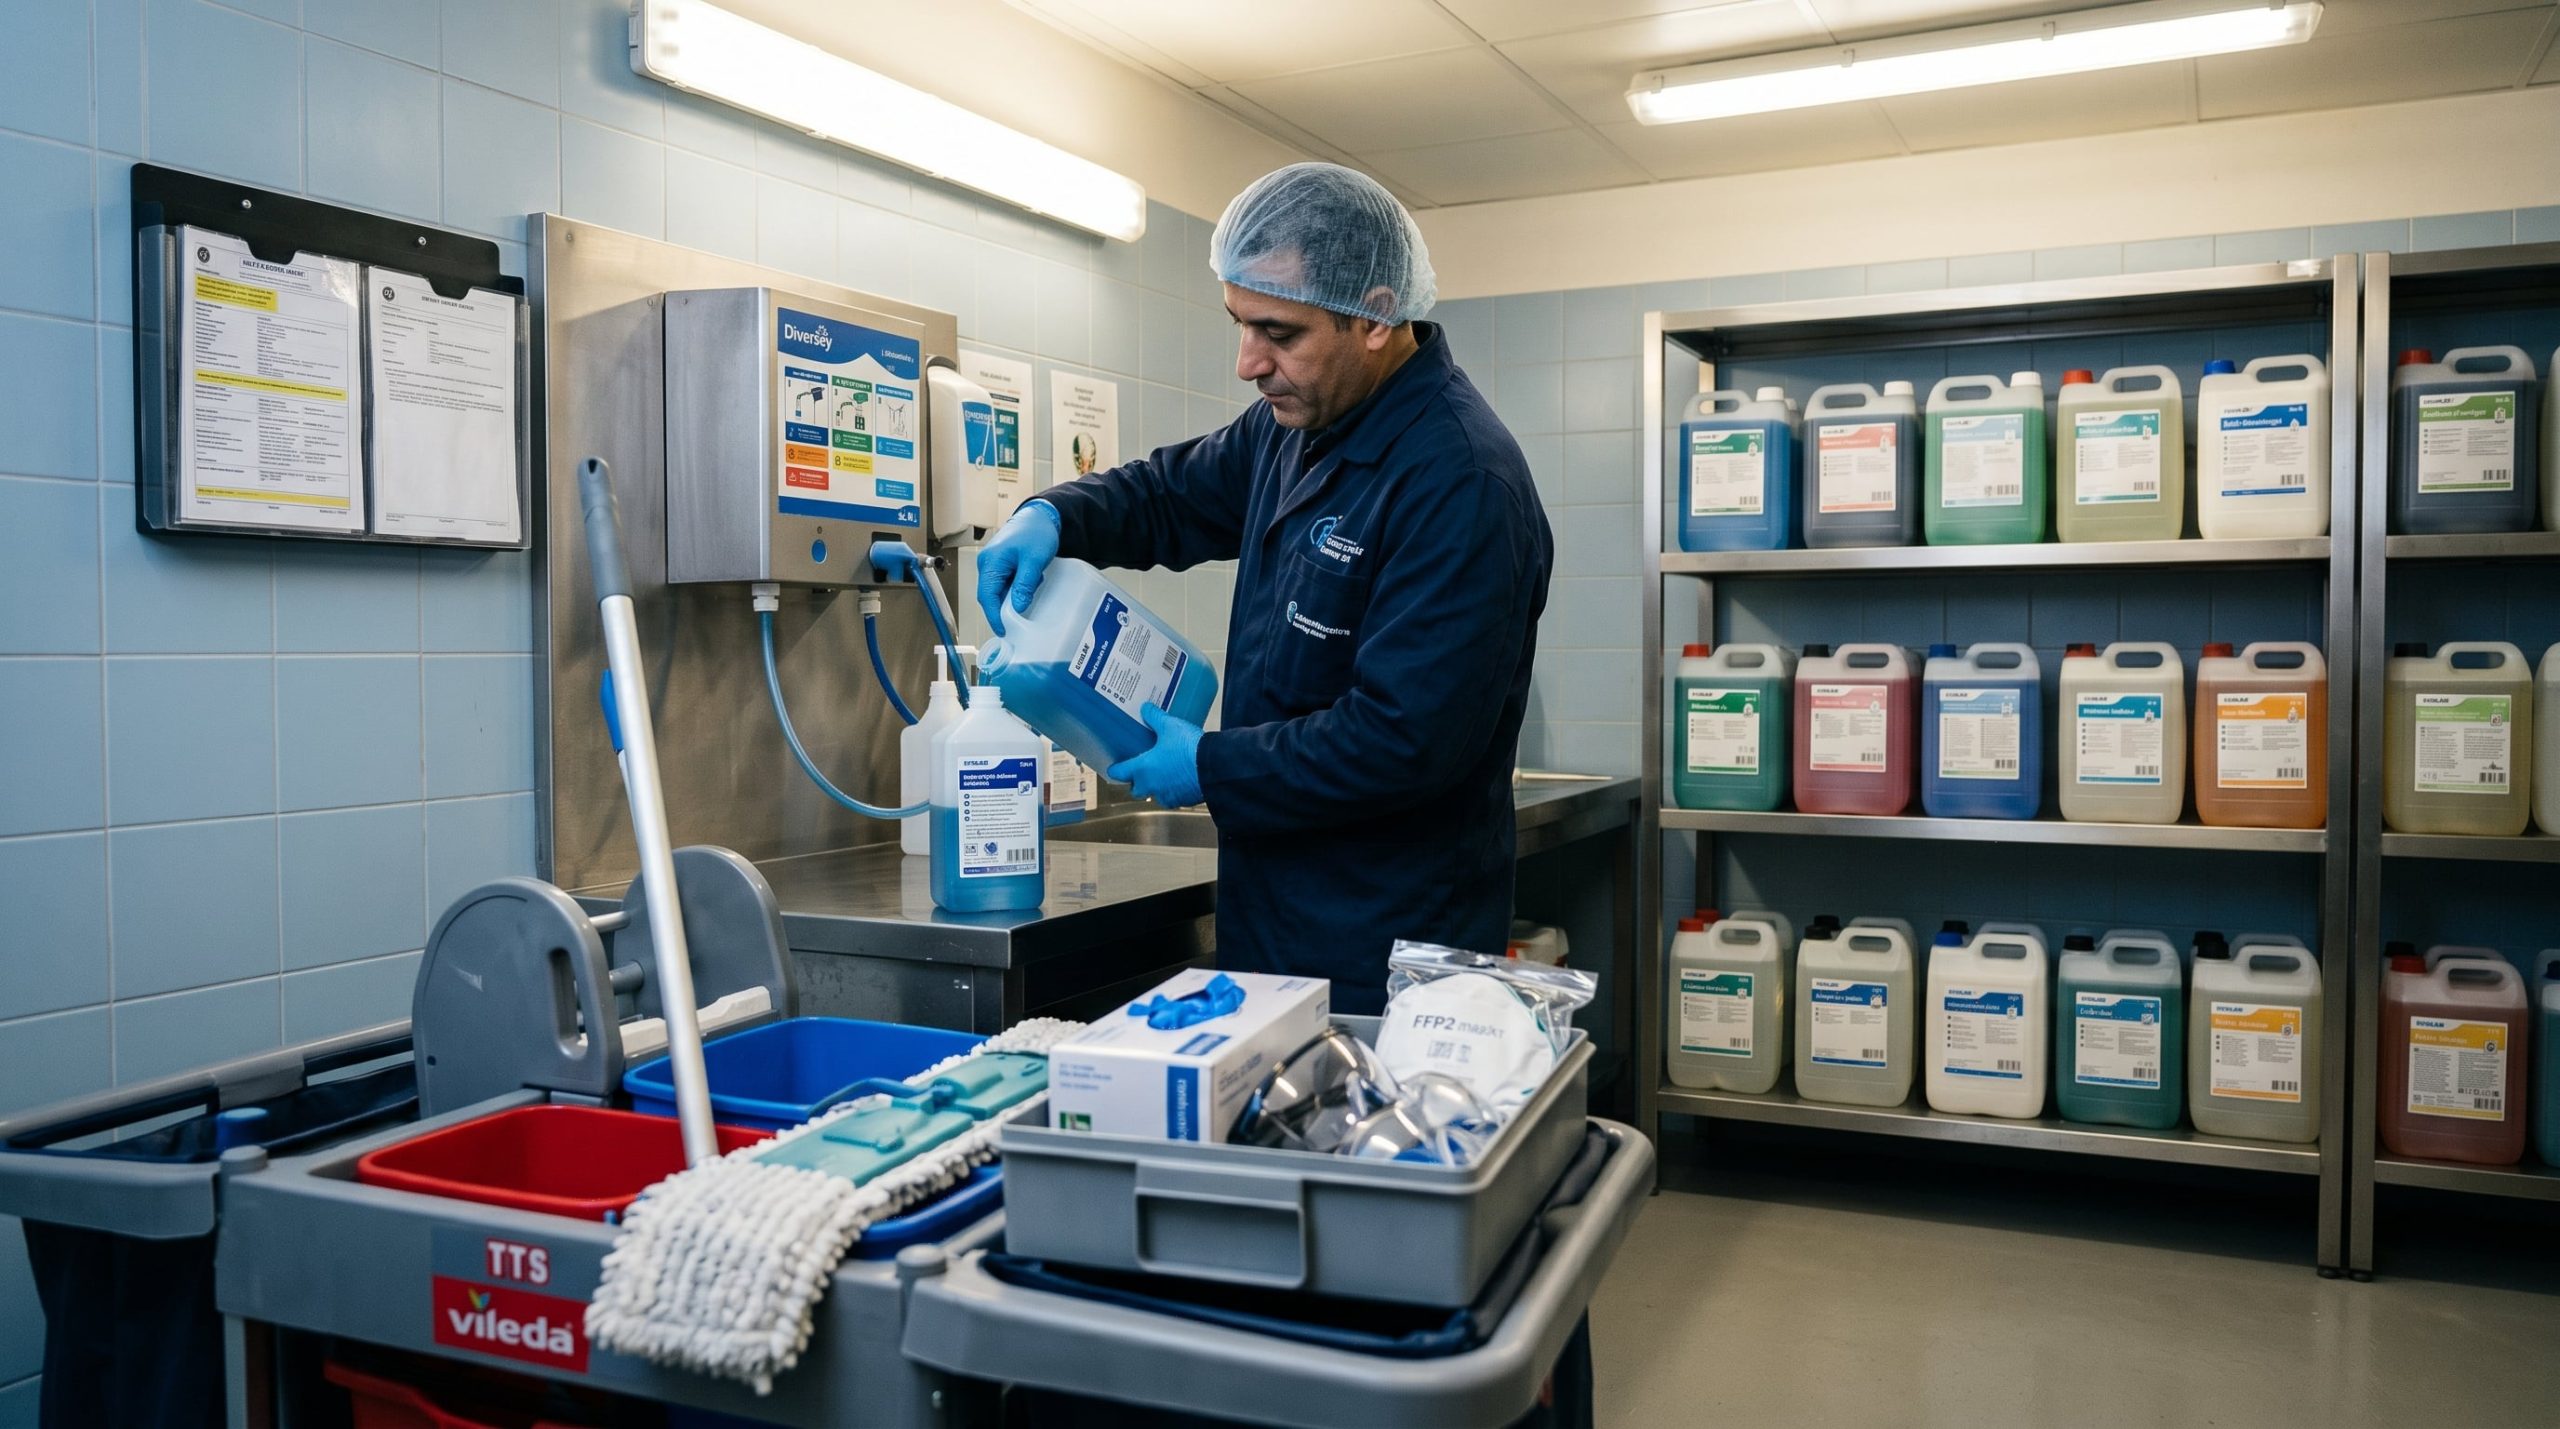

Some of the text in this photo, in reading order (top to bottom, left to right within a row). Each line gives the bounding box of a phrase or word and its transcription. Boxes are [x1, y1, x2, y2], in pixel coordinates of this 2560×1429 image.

[784, 323, 833, 352] Diversey
[1412, 1014, 1456, 1031] FFP2
[487, 1242, 549, 1284] TTS
[447, 1307, 575, 1356] vileda
